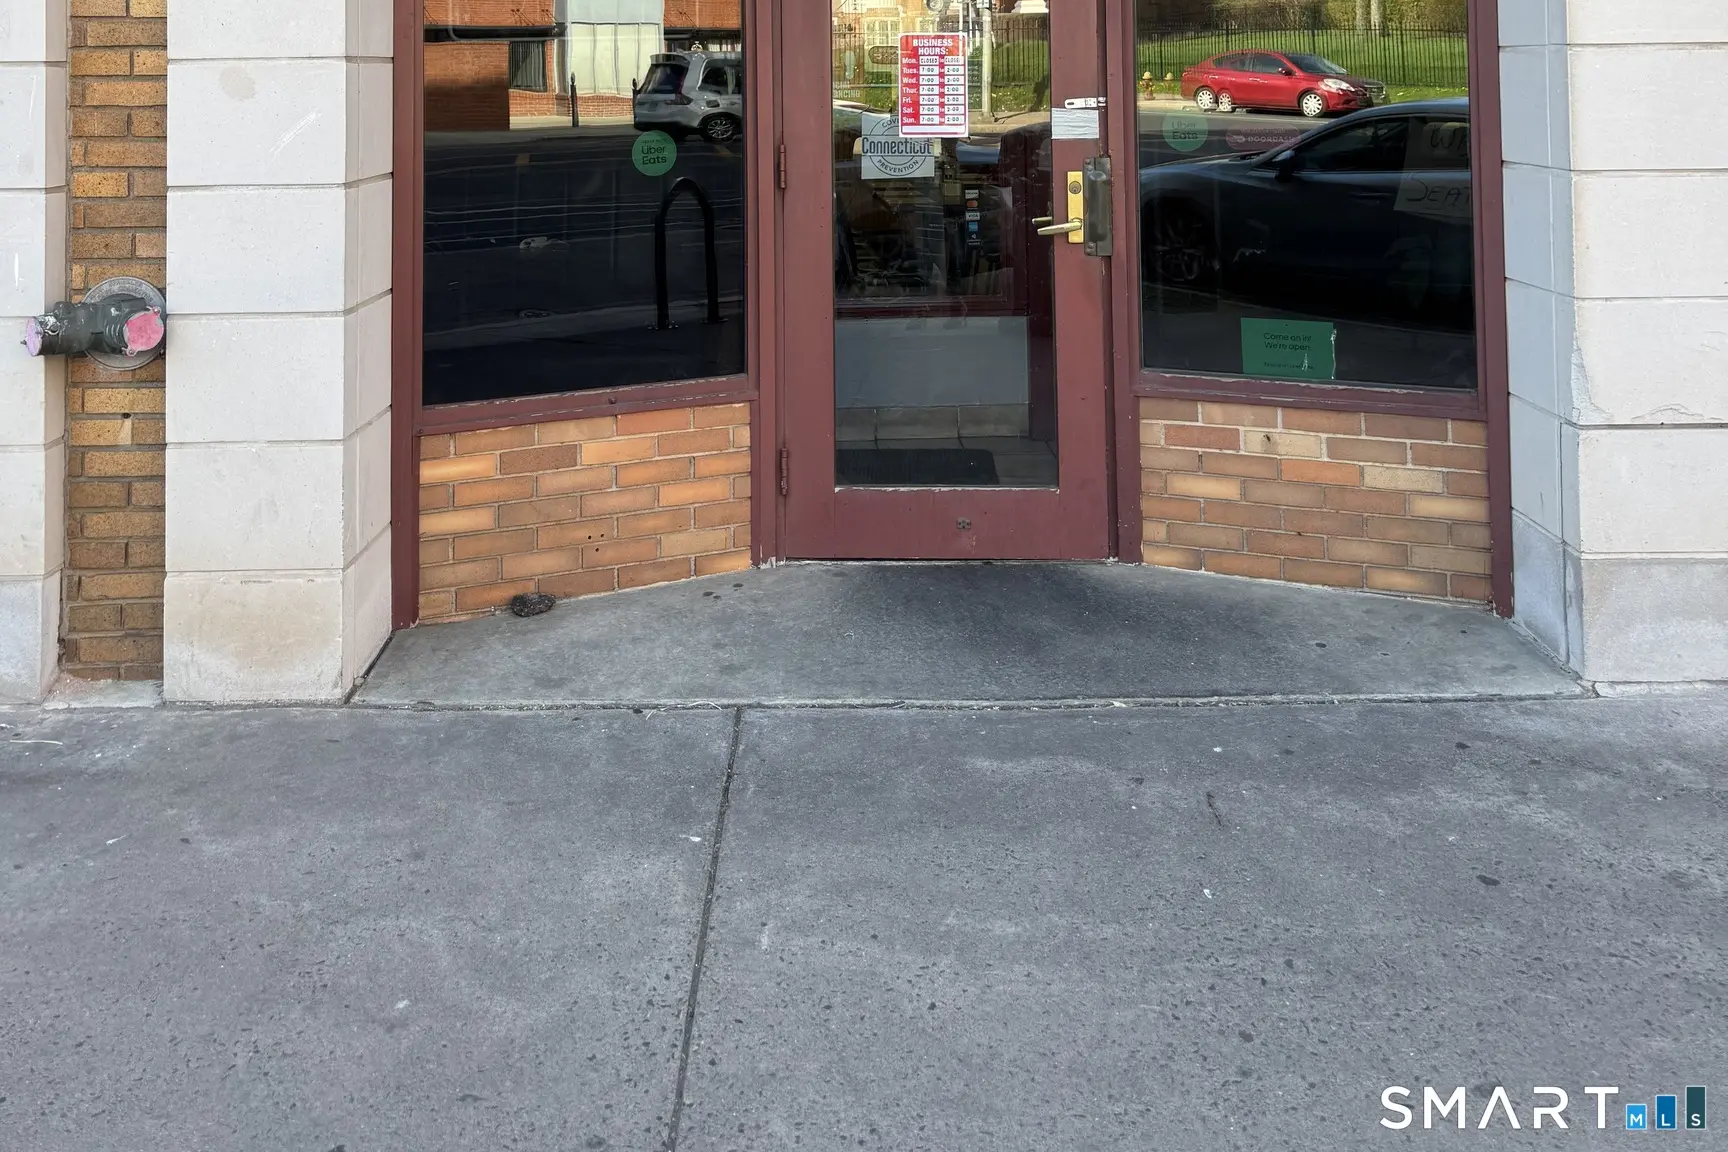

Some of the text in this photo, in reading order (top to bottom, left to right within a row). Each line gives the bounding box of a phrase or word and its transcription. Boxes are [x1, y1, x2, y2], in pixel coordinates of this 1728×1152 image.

[912, 38, 953, 47] BUSINESS
[918, 47, 949, 55] HOURS:
[881, 117, 899, 128] COVI
[1172, 131, 1198, 140] Eats
[641, 145, 666, 154] Uber
[862, 137, 932, 154] Connecticut
[642, 155, 667, 165] Eats
[876, 159, 919, 173] PREVENTION
[1263, 332, 1288, 341] Come
